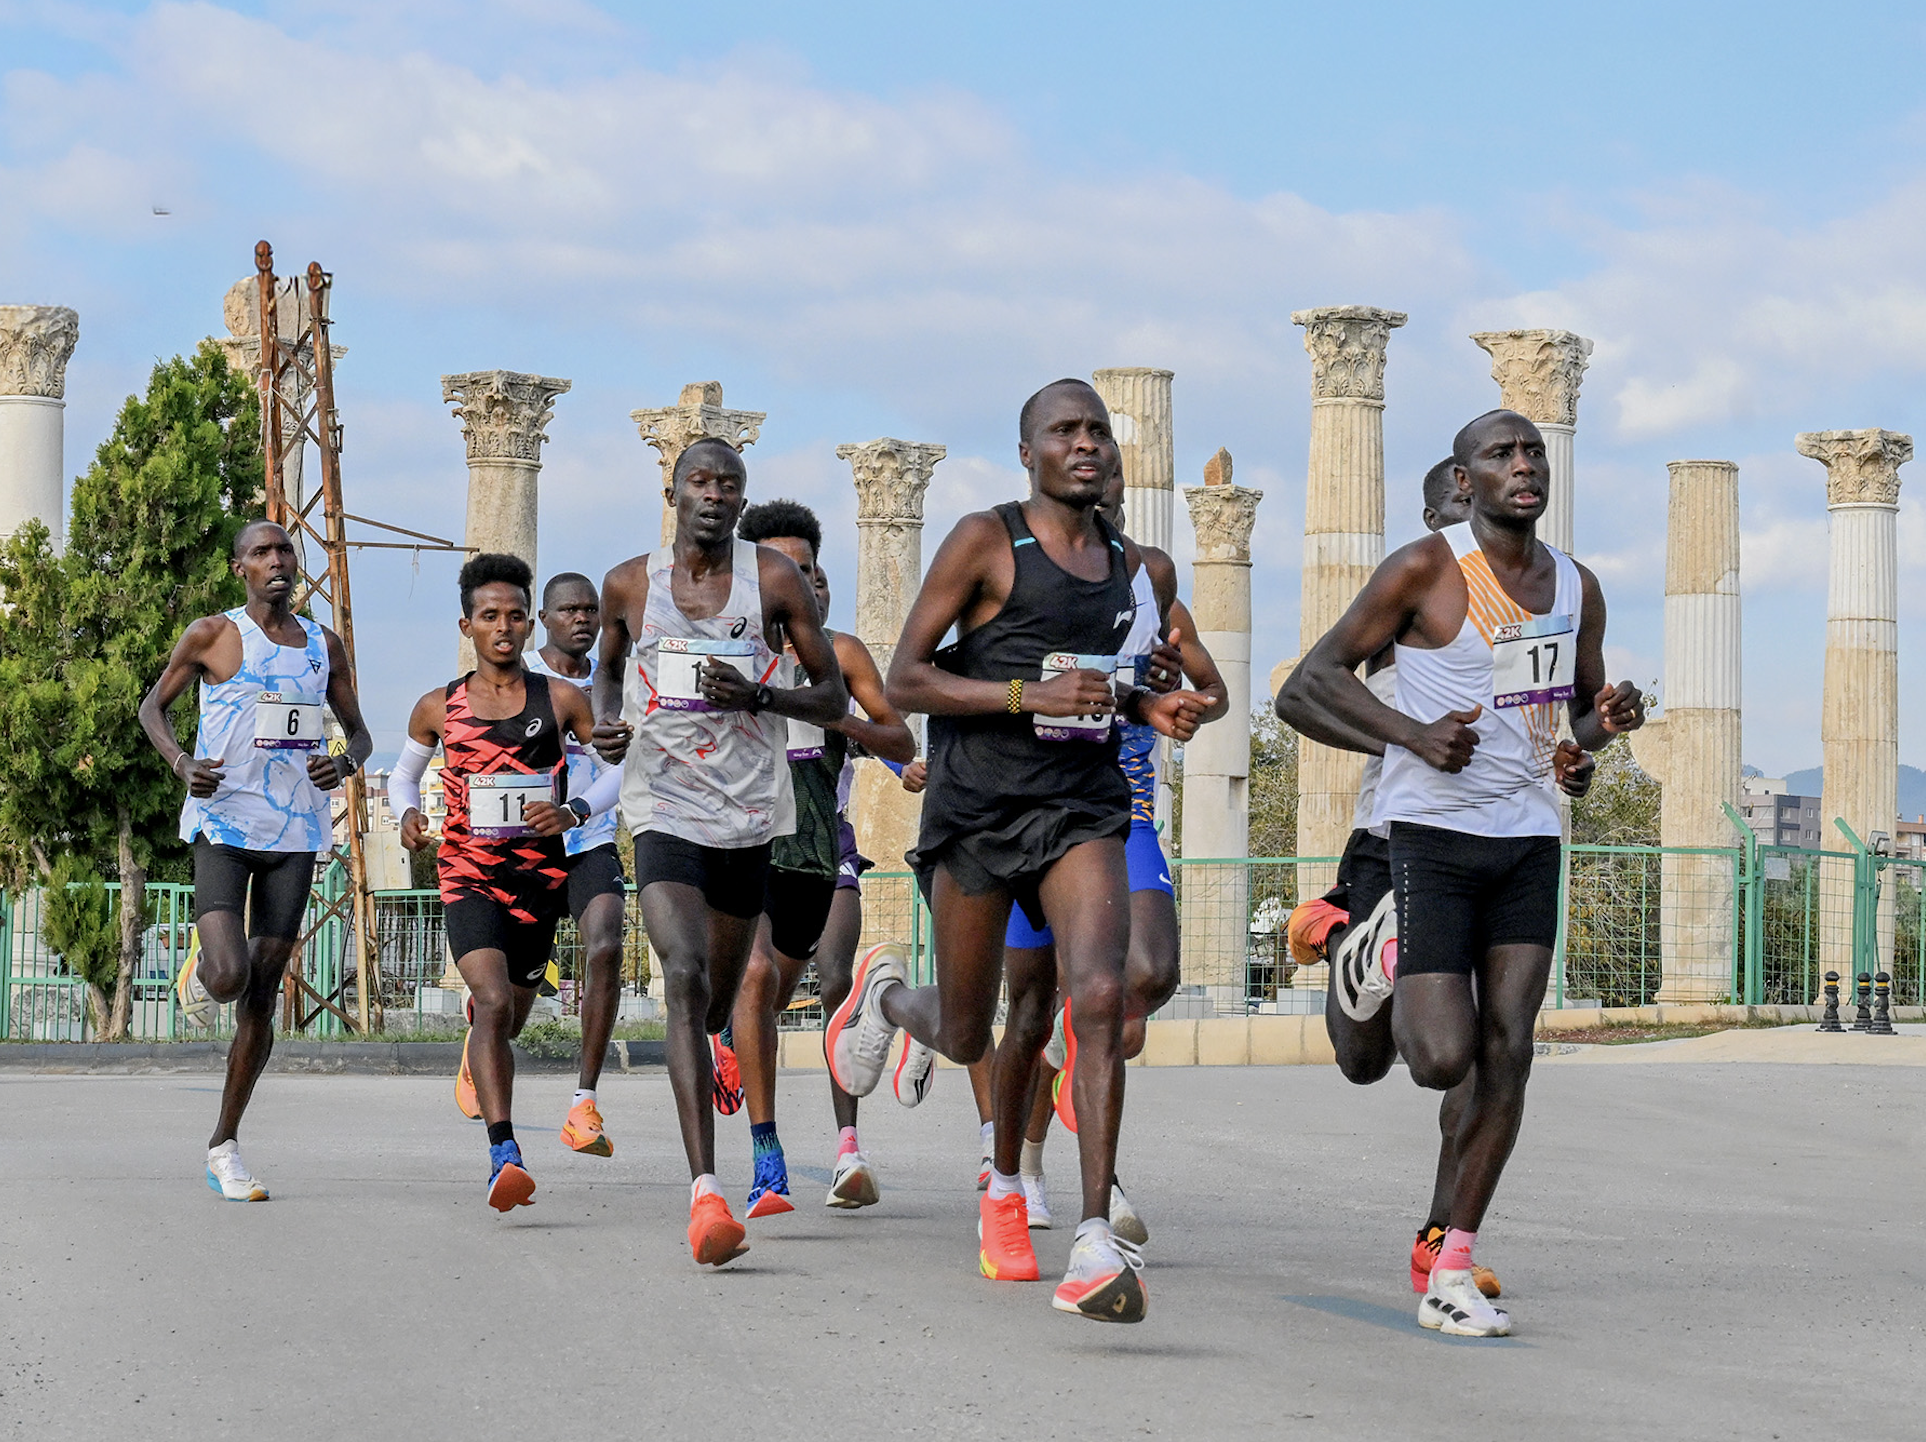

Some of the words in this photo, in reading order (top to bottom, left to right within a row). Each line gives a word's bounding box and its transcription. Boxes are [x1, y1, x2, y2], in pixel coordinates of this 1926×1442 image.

[663, 639, 688, 652] 42K
[1050, 655, 1078, 669] 42K
[1527, 642, 1558, 684] 17
[691, 661, 702, 693] 1
[260, 692, 282, 703] 42K
[287, 708, 300, 736] 6
[473, 776, 495, 787] 42K
[499, 793, 526, 822] 11
